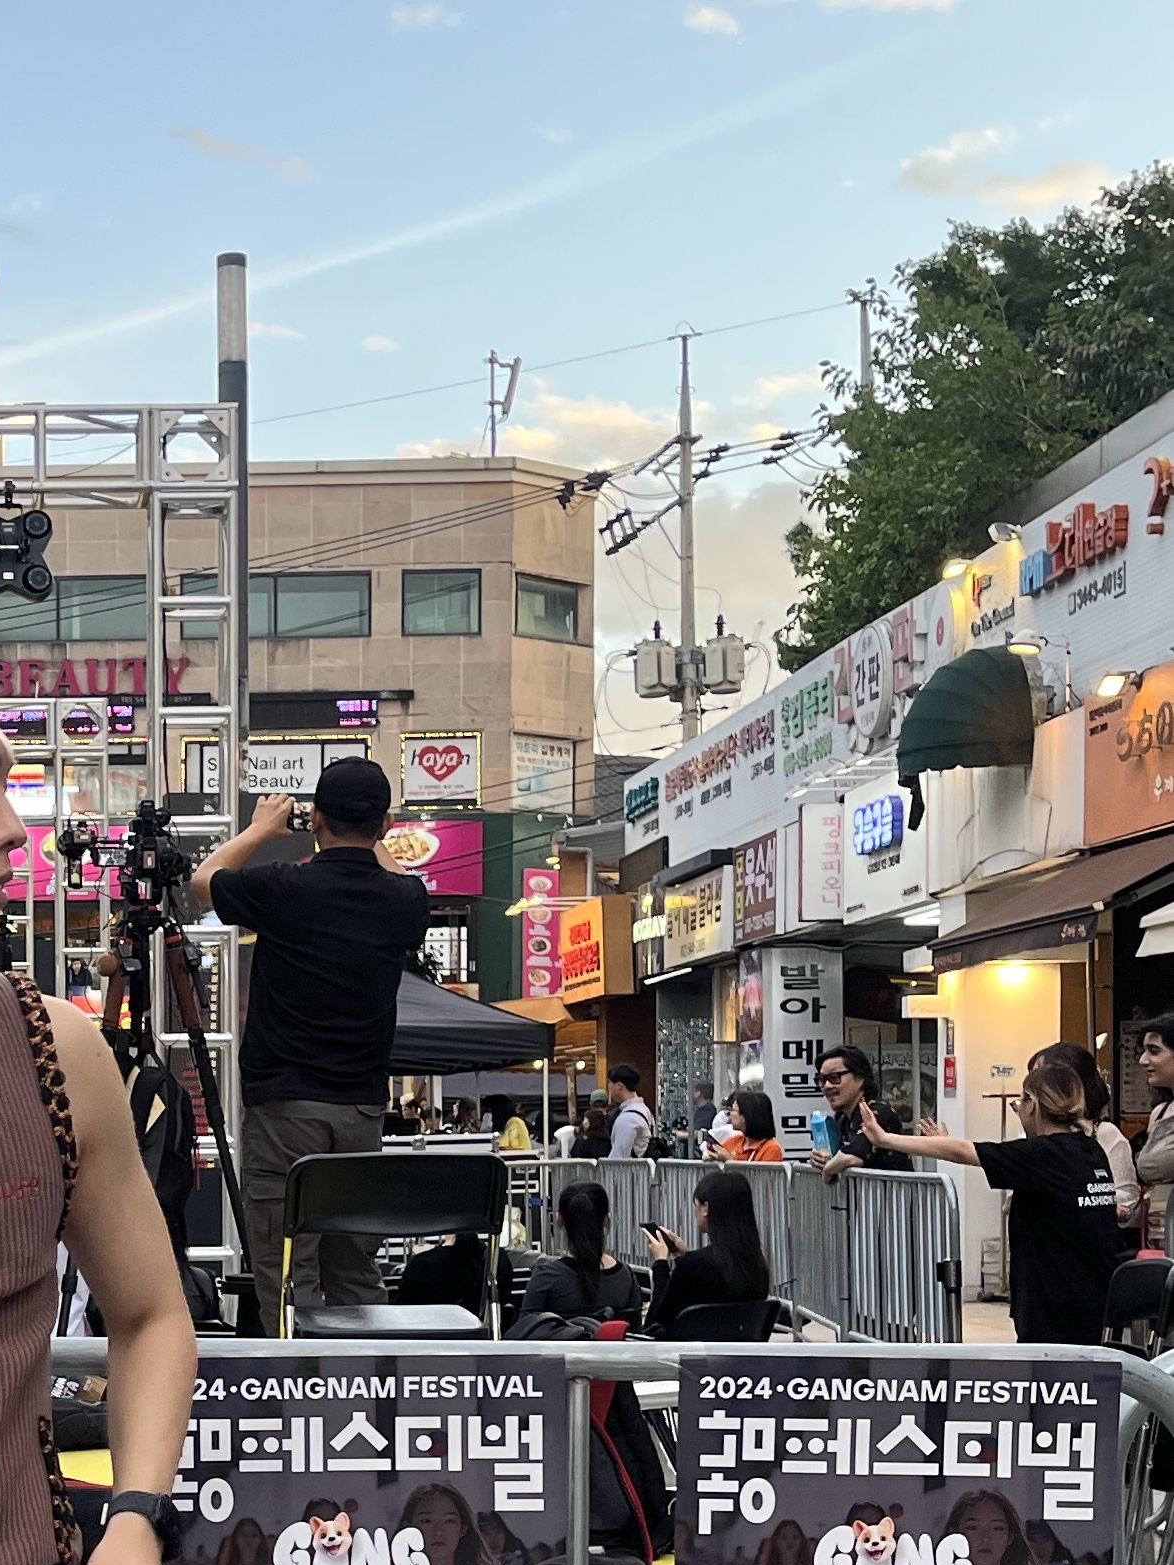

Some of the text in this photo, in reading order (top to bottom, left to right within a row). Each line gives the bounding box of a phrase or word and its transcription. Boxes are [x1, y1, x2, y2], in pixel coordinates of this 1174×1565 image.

[855, 652, 880, 709] 간판
[249, 756, 304, 770] Nail art
[248, 774, 304, 789] Beauty
[402, 1375, 543, 1399] FESTIVAL
[954, 1379, 1098, 1406] FESTIVAL
